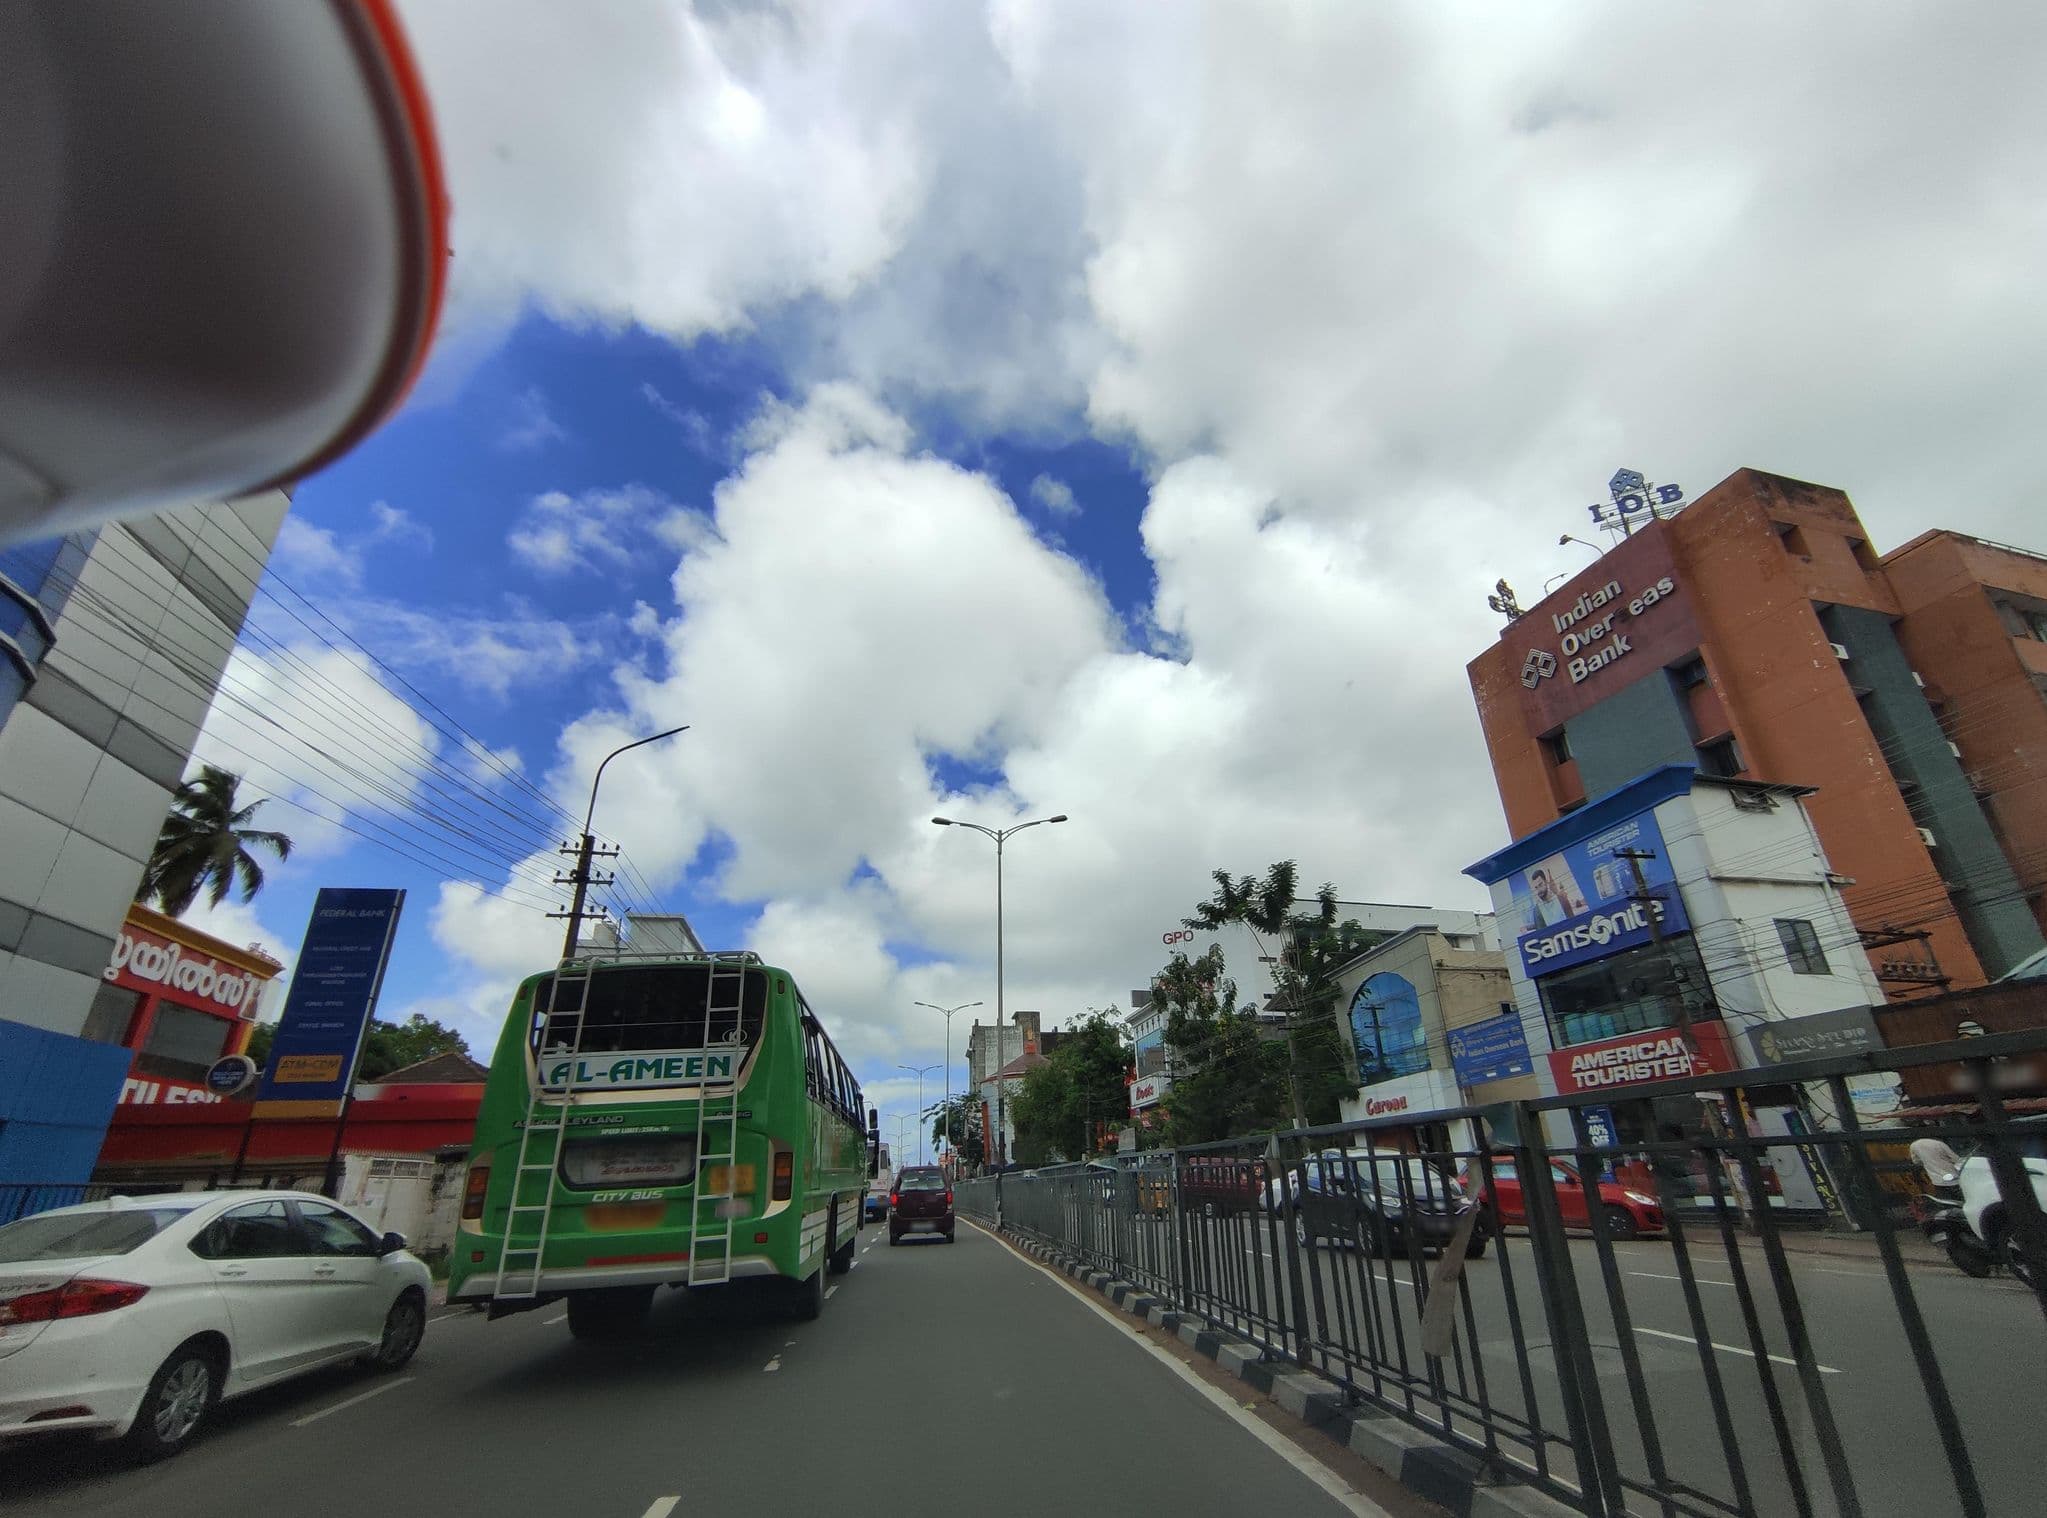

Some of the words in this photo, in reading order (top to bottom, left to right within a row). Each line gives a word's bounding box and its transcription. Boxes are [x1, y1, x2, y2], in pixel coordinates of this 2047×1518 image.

[1553, 579, 1623, 635] Indian
[1567, 633, 1633, 684] Bank
[1587, 821, 1639, 850] AMERICAN
[1587, 829, 1640, 858] TOURISTER
[1162, 930, 1194, 945] GPO
[1571, 1037, 1690, 1072] AMERICAN
[550, 1056, 731, 1085] AL-AMEEN
[1571, 1055, 1691, 1088] TOURISTER
[567, 1115, 625, 1126] LEYLAND
[1588, 1124, 1609, 1136] 40%
[1591, 1135, 1610, 1147] OFF
[592, 1190, 629, 1203] CITY
[630, 1188, 665, 1201] BUS
